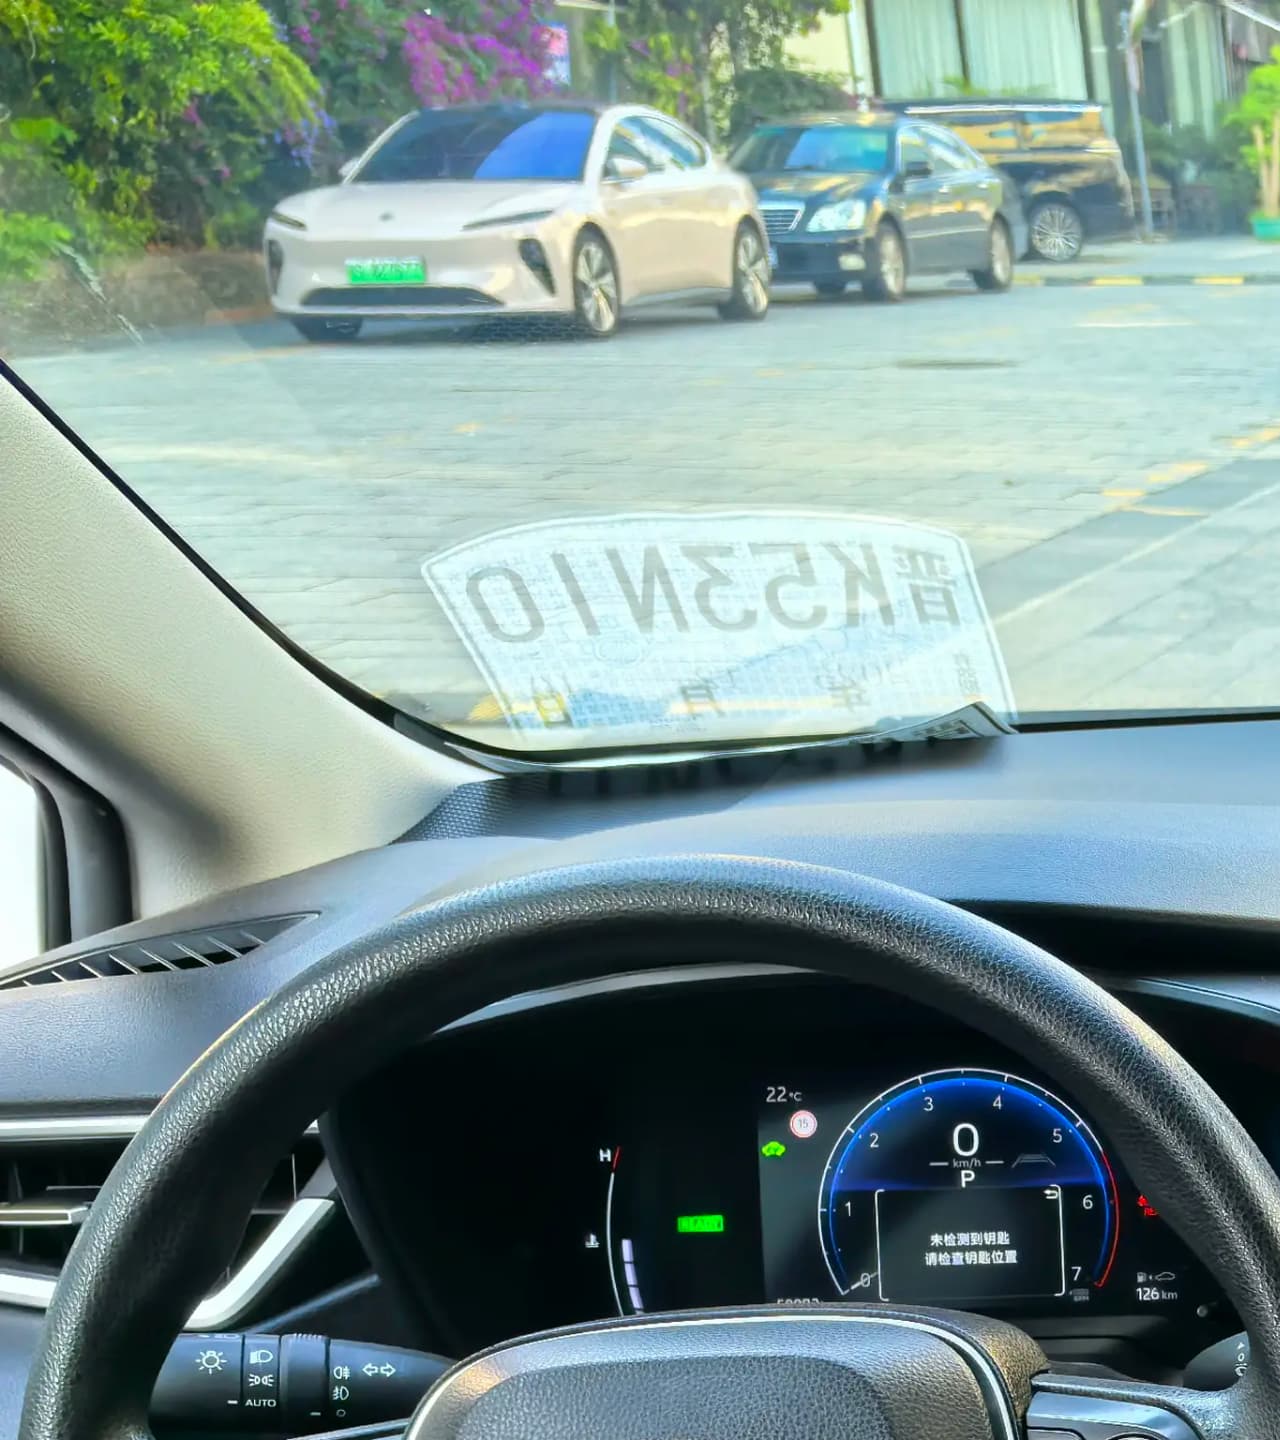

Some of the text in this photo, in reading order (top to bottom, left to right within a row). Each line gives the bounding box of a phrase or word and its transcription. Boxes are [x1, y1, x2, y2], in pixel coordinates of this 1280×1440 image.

[923, 1097, 934, 1112] 3
[992, 1097, 1002, 1110] 4
[797, 1118, 809, 1129] 15
[869, 1133, 880, 1148] 2
[952, 1123, 980, 1157] 0
[1052, 1128, 1063, 1143] 5
[600, 1149, 611, 1162] H
[952, 1157, 981, 1169] km/h
[960, 1169, 976, 1188] P
[844, 1201, 852, 1217] 1
[1082, 1194, 1093, 1210] 6
[930, 1231, 1010, 1247] 未检测到钥匙
[925, 1250, 1018, 1266] 请检查钥匙位置
[860, 1272, 871, 1288] 0
[1071, 1266, 1082, 1281] 7
[1136, 1287, 1178, 1301] 126 km
[245, 1399, 277, 1408] AUTO
